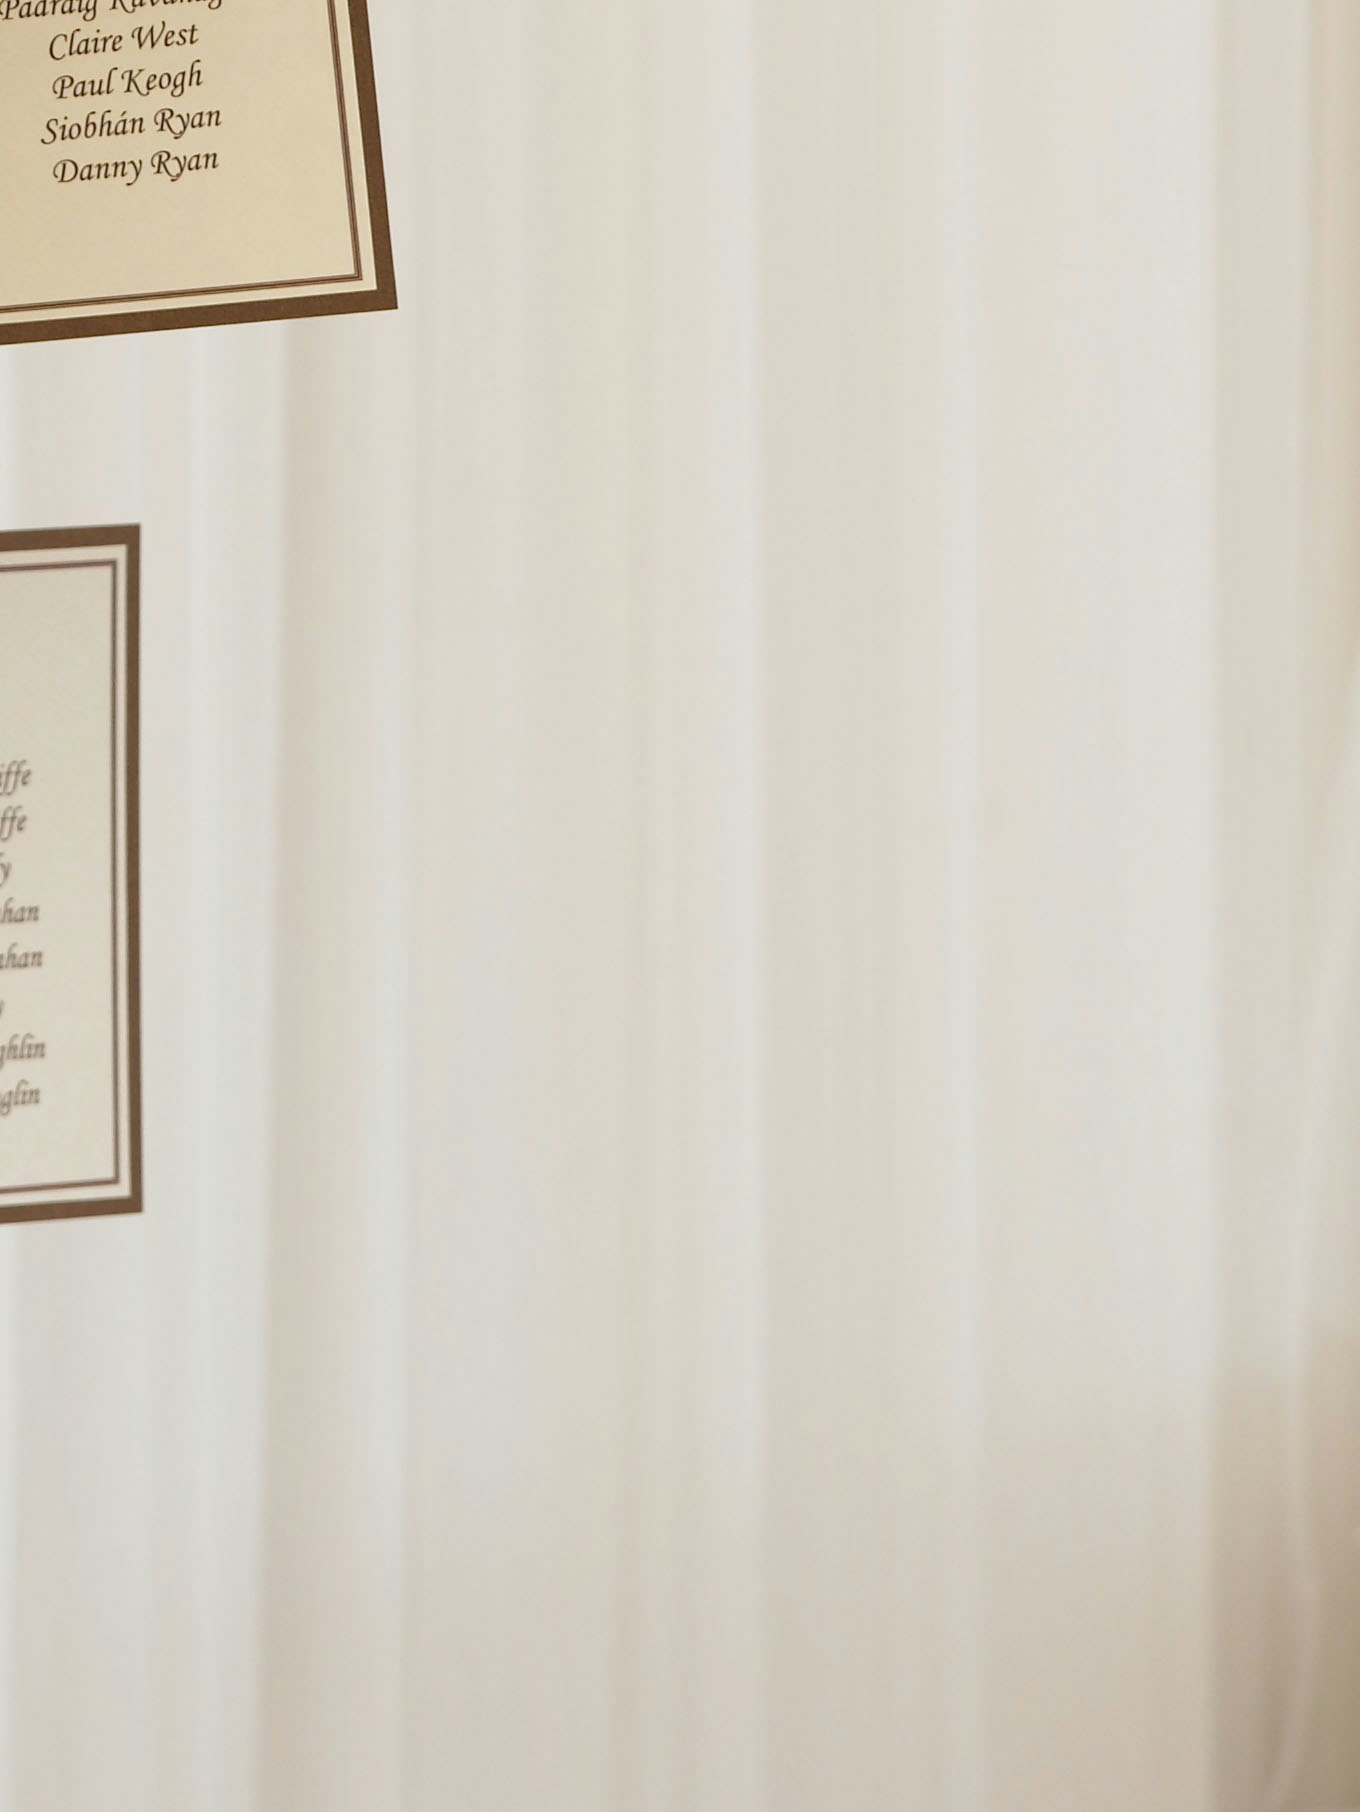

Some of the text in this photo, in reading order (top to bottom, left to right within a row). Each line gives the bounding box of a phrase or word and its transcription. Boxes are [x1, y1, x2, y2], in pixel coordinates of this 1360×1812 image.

[48, 20, 199, 61] Claire West
[51, 58, 203, 100] Paul Keogh
[40, 107, 222, 145] Siobhán Ryan
[52, 150, 219, 187] Danny Ryan
